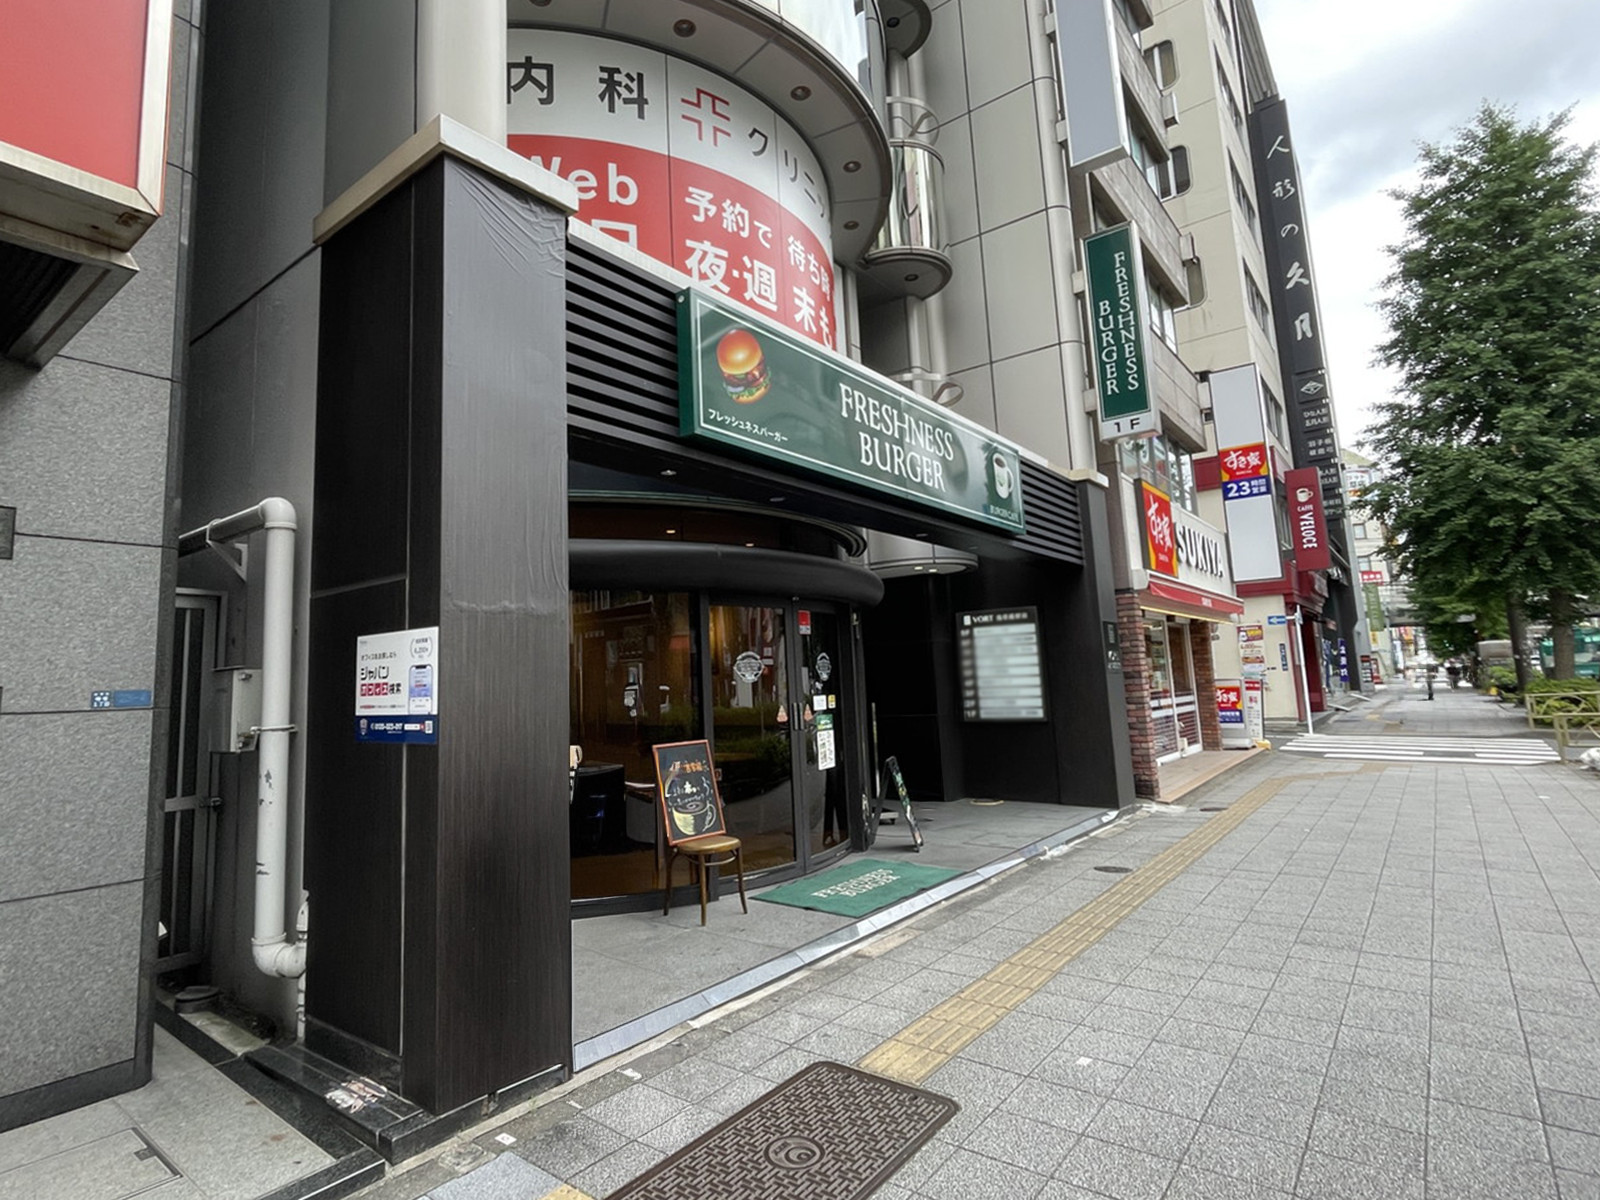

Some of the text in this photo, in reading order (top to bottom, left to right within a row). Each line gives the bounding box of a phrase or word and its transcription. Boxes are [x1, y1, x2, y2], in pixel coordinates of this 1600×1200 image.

[507, 56, 649, 120] 内科
[1267, 135, 1313, 341] 人形の久月
[1099, 300, 1120, 396] BURGER
[1114, 251, 1139, 391] FRESHNESS
[708, 408, 789, 442] フレッシュネスバーガー
[839, 382, 954, 461] FRESHNESS
[1114, 418, 1141, 433] 1F
[859, 431, 946, 493] BURGER
[1223, 450, 1262, 471] すき家
[1226, 481, 1252, 498] 23
[1174, 523, 1225, 579] SUKIYA
[1299, 512, 1318, 549] VELOCE
